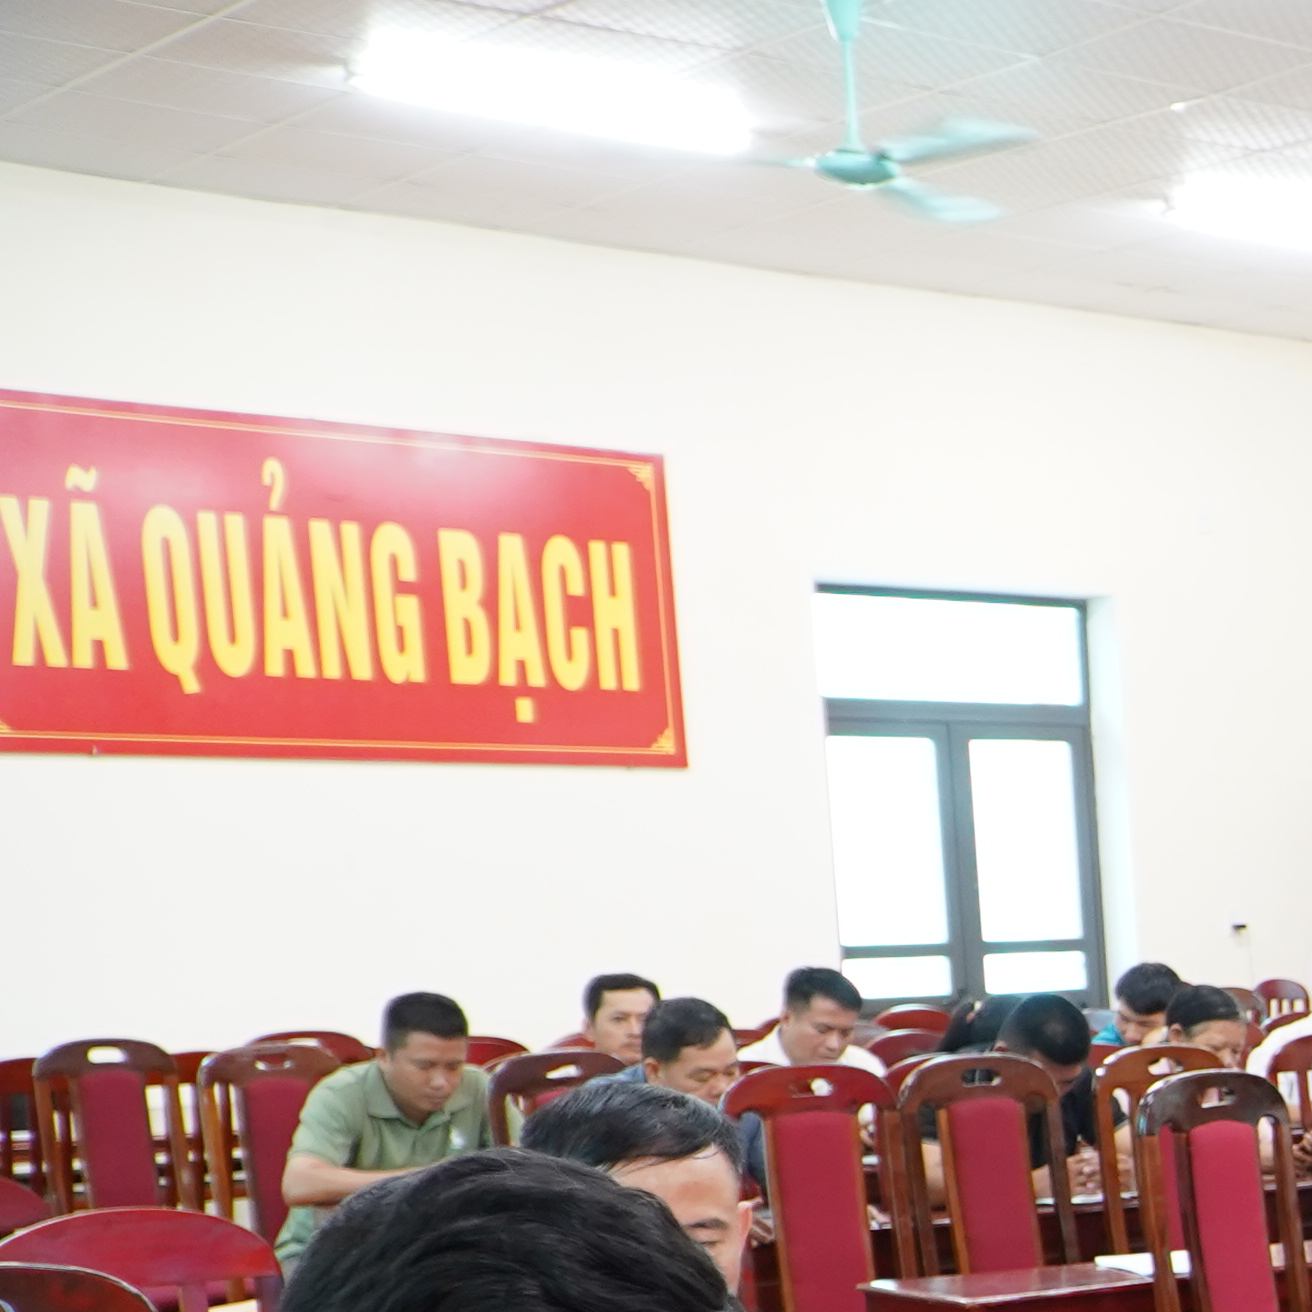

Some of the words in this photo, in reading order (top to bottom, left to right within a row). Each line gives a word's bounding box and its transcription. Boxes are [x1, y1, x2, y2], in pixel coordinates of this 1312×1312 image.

[0, 464, 129, 671] XÃ
[141, 457, 427, 695] QUẢNG
[438, 527, 641, 723] BẠCH
